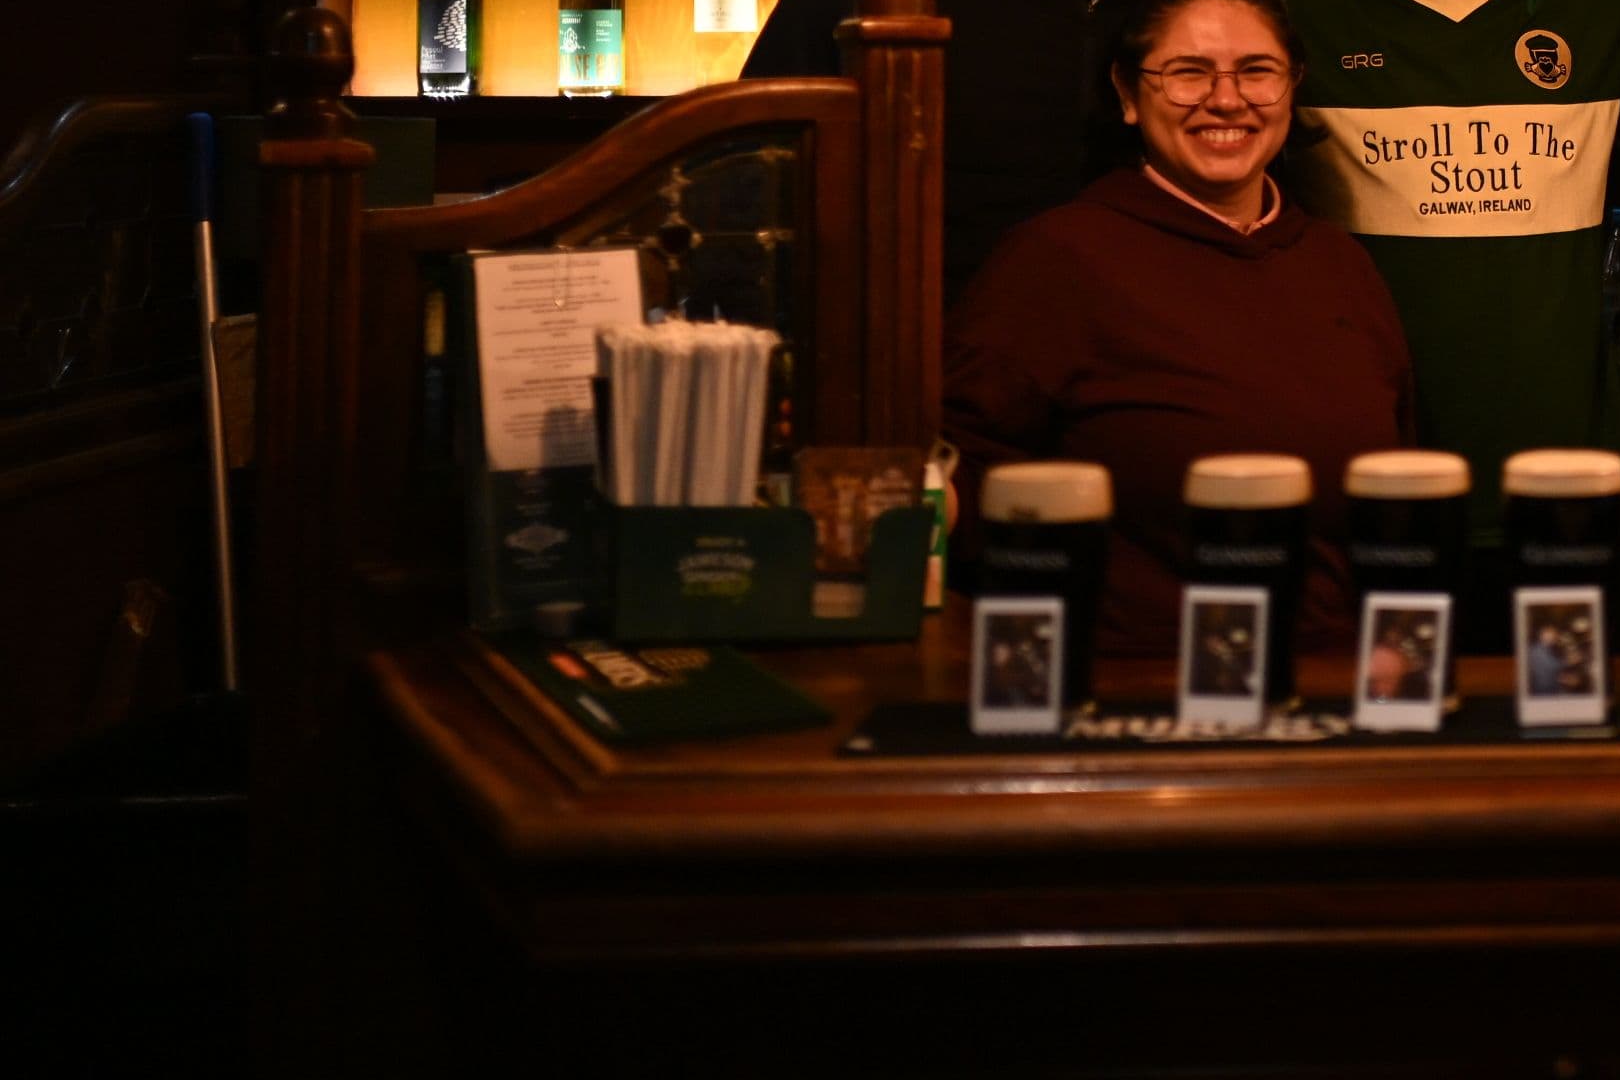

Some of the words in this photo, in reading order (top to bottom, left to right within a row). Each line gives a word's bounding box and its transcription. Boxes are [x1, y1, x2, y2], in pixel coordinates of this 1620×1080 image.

[1341, 53, 1384, 69] GRG
[1362, 123, 1453, 165] Stroll
[1468, 121, 1509, 156] To
[1524, 122, 1575, 161] The
[1430, 160, 1522, 194] Stout
[1419, 200, 1477, 217] GALWAY,
[1479, 198, 1532, 213] IRELAND
